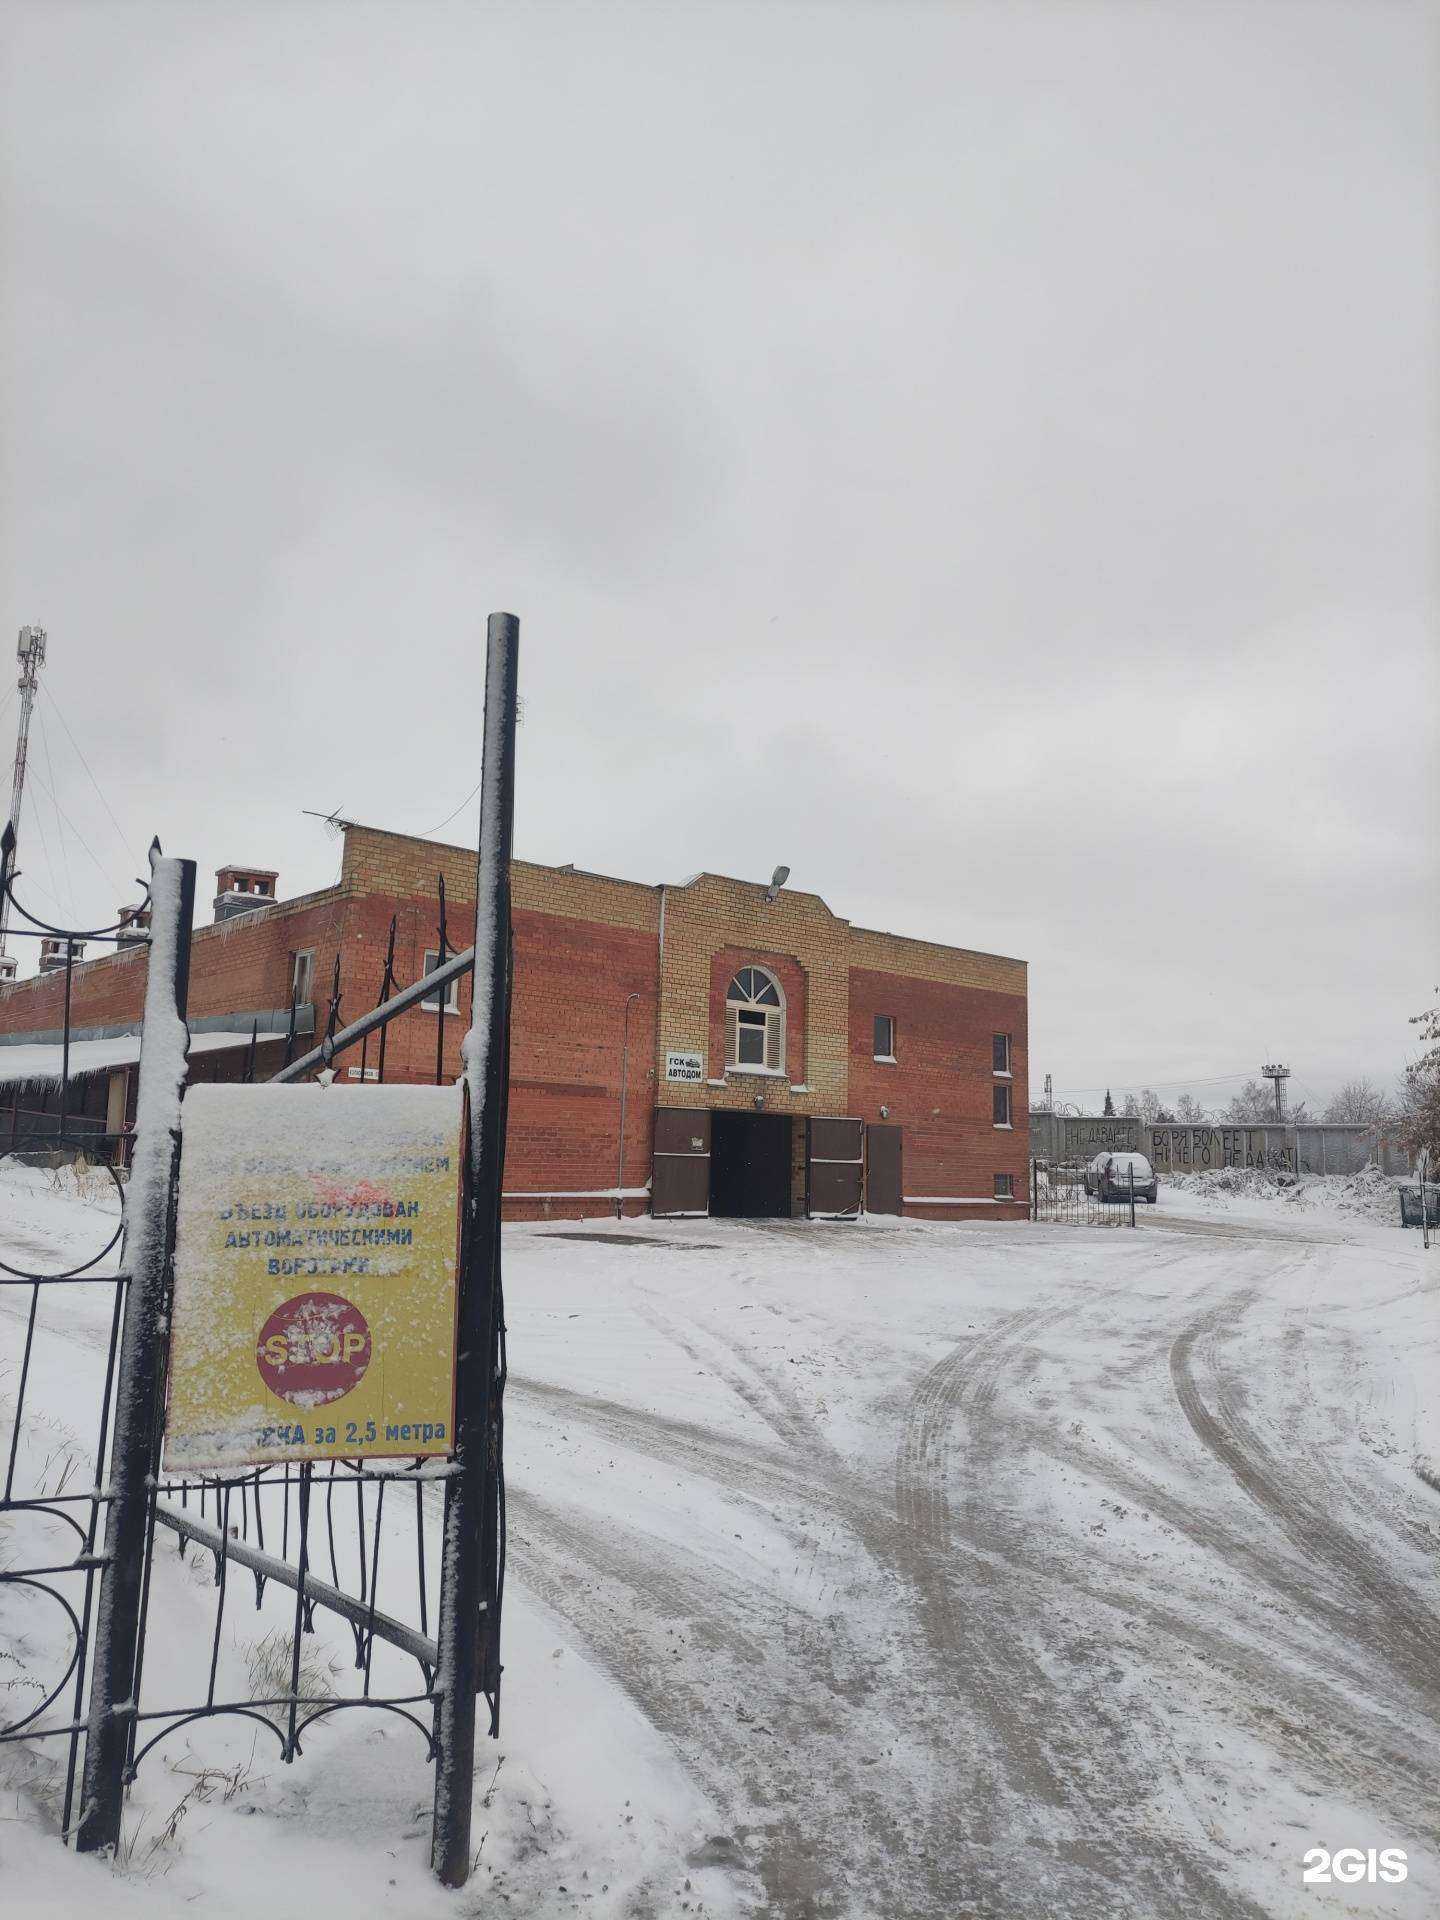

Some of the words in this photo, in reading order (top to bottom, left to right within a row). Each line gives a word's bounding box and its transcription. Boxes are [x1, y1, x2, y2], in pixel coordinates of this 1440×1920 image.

[669, 1058, 685, 1066] ГСК
[668, 1069, 701, 1079] АВТОДОМ
[315, 1428, 336, 1444] за
[345, 1422, 377, 1446] 2,5
[386, 1423, 446, 1443] метра
